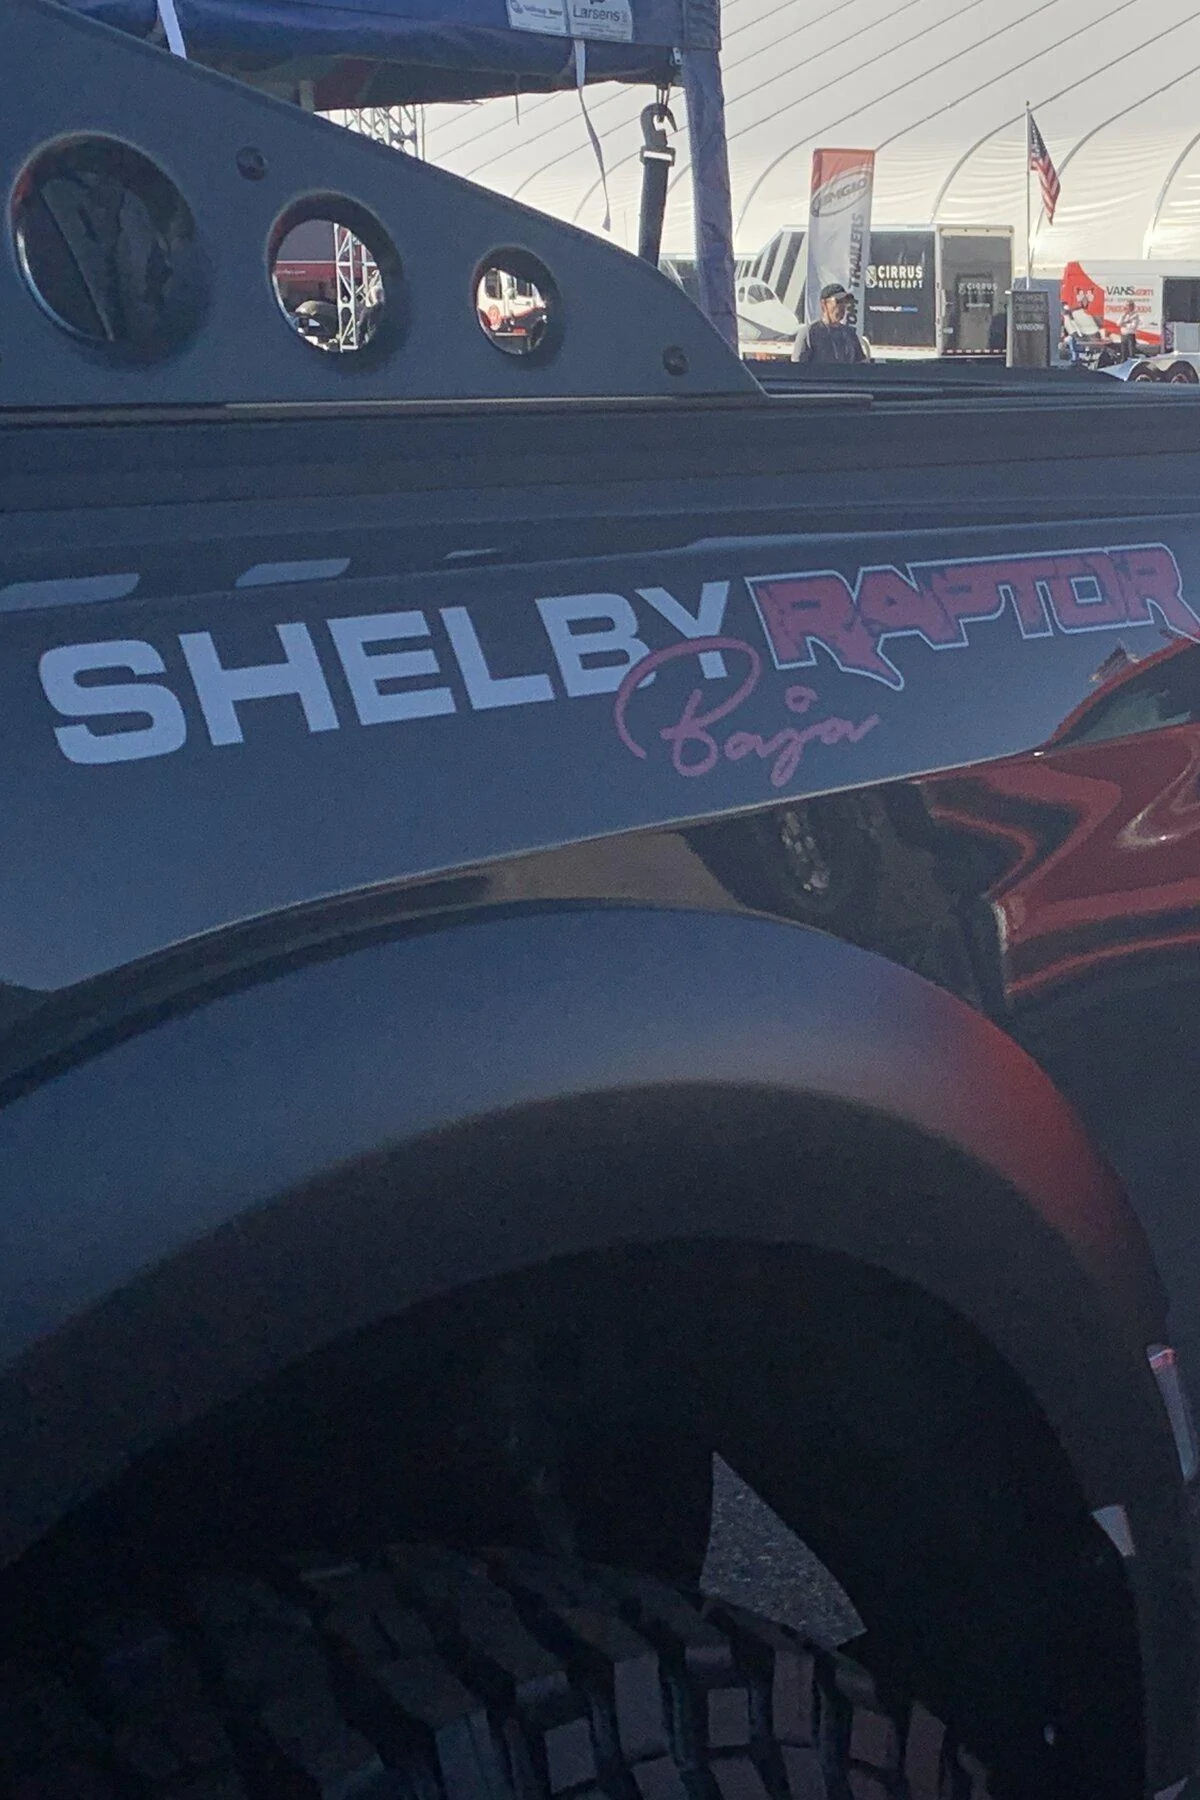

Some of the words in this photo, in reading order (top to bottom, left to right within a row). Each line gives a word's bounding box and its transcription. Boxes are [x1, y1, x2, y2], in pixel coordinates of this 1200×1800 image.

[572, 4, 621, 21] Larsens
[877, 264, 923, 279] CIRRUS
[878, 280, 923, 289] AIRCRAFT
[38, 580, 730, 765] SHELBY
[612, 636, 880, 788] Baja
